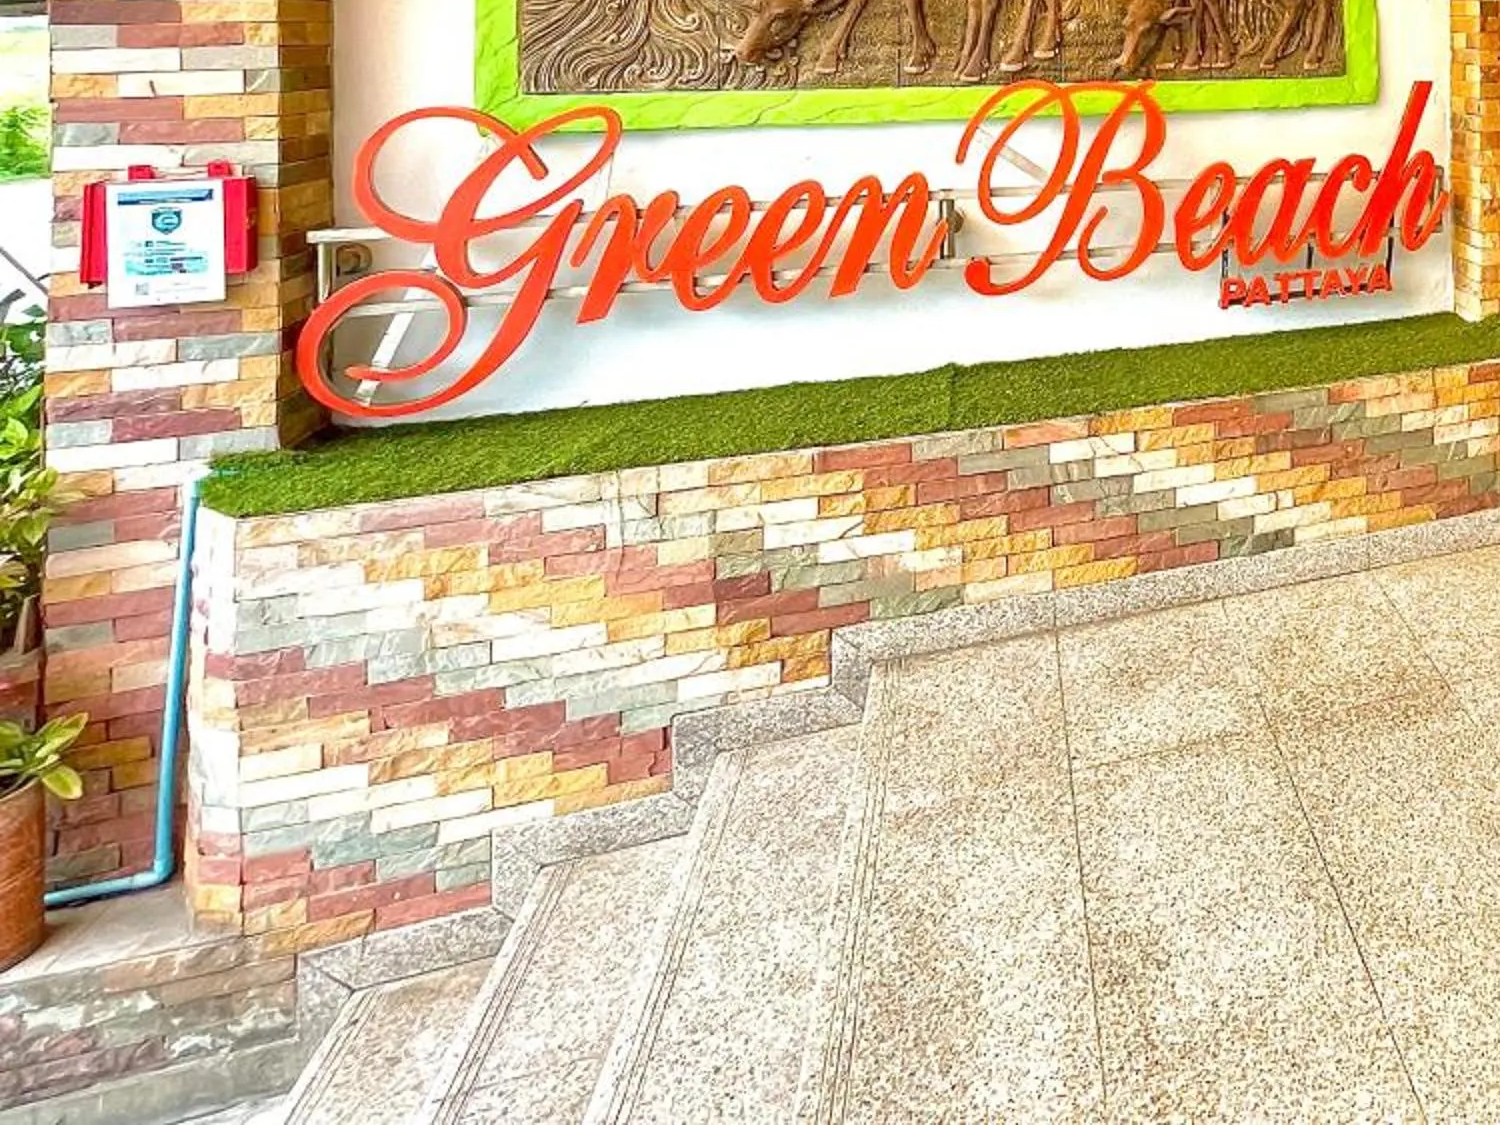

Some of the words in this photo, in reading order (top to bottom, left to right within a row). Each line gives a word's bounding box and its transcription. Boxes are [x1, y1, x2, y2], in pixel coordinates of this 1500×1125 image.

[296, 105, 948, 417] Green
[955, 79, 1449, 297] Beach
[1219, 263, 1393, 309] PATTAYA
